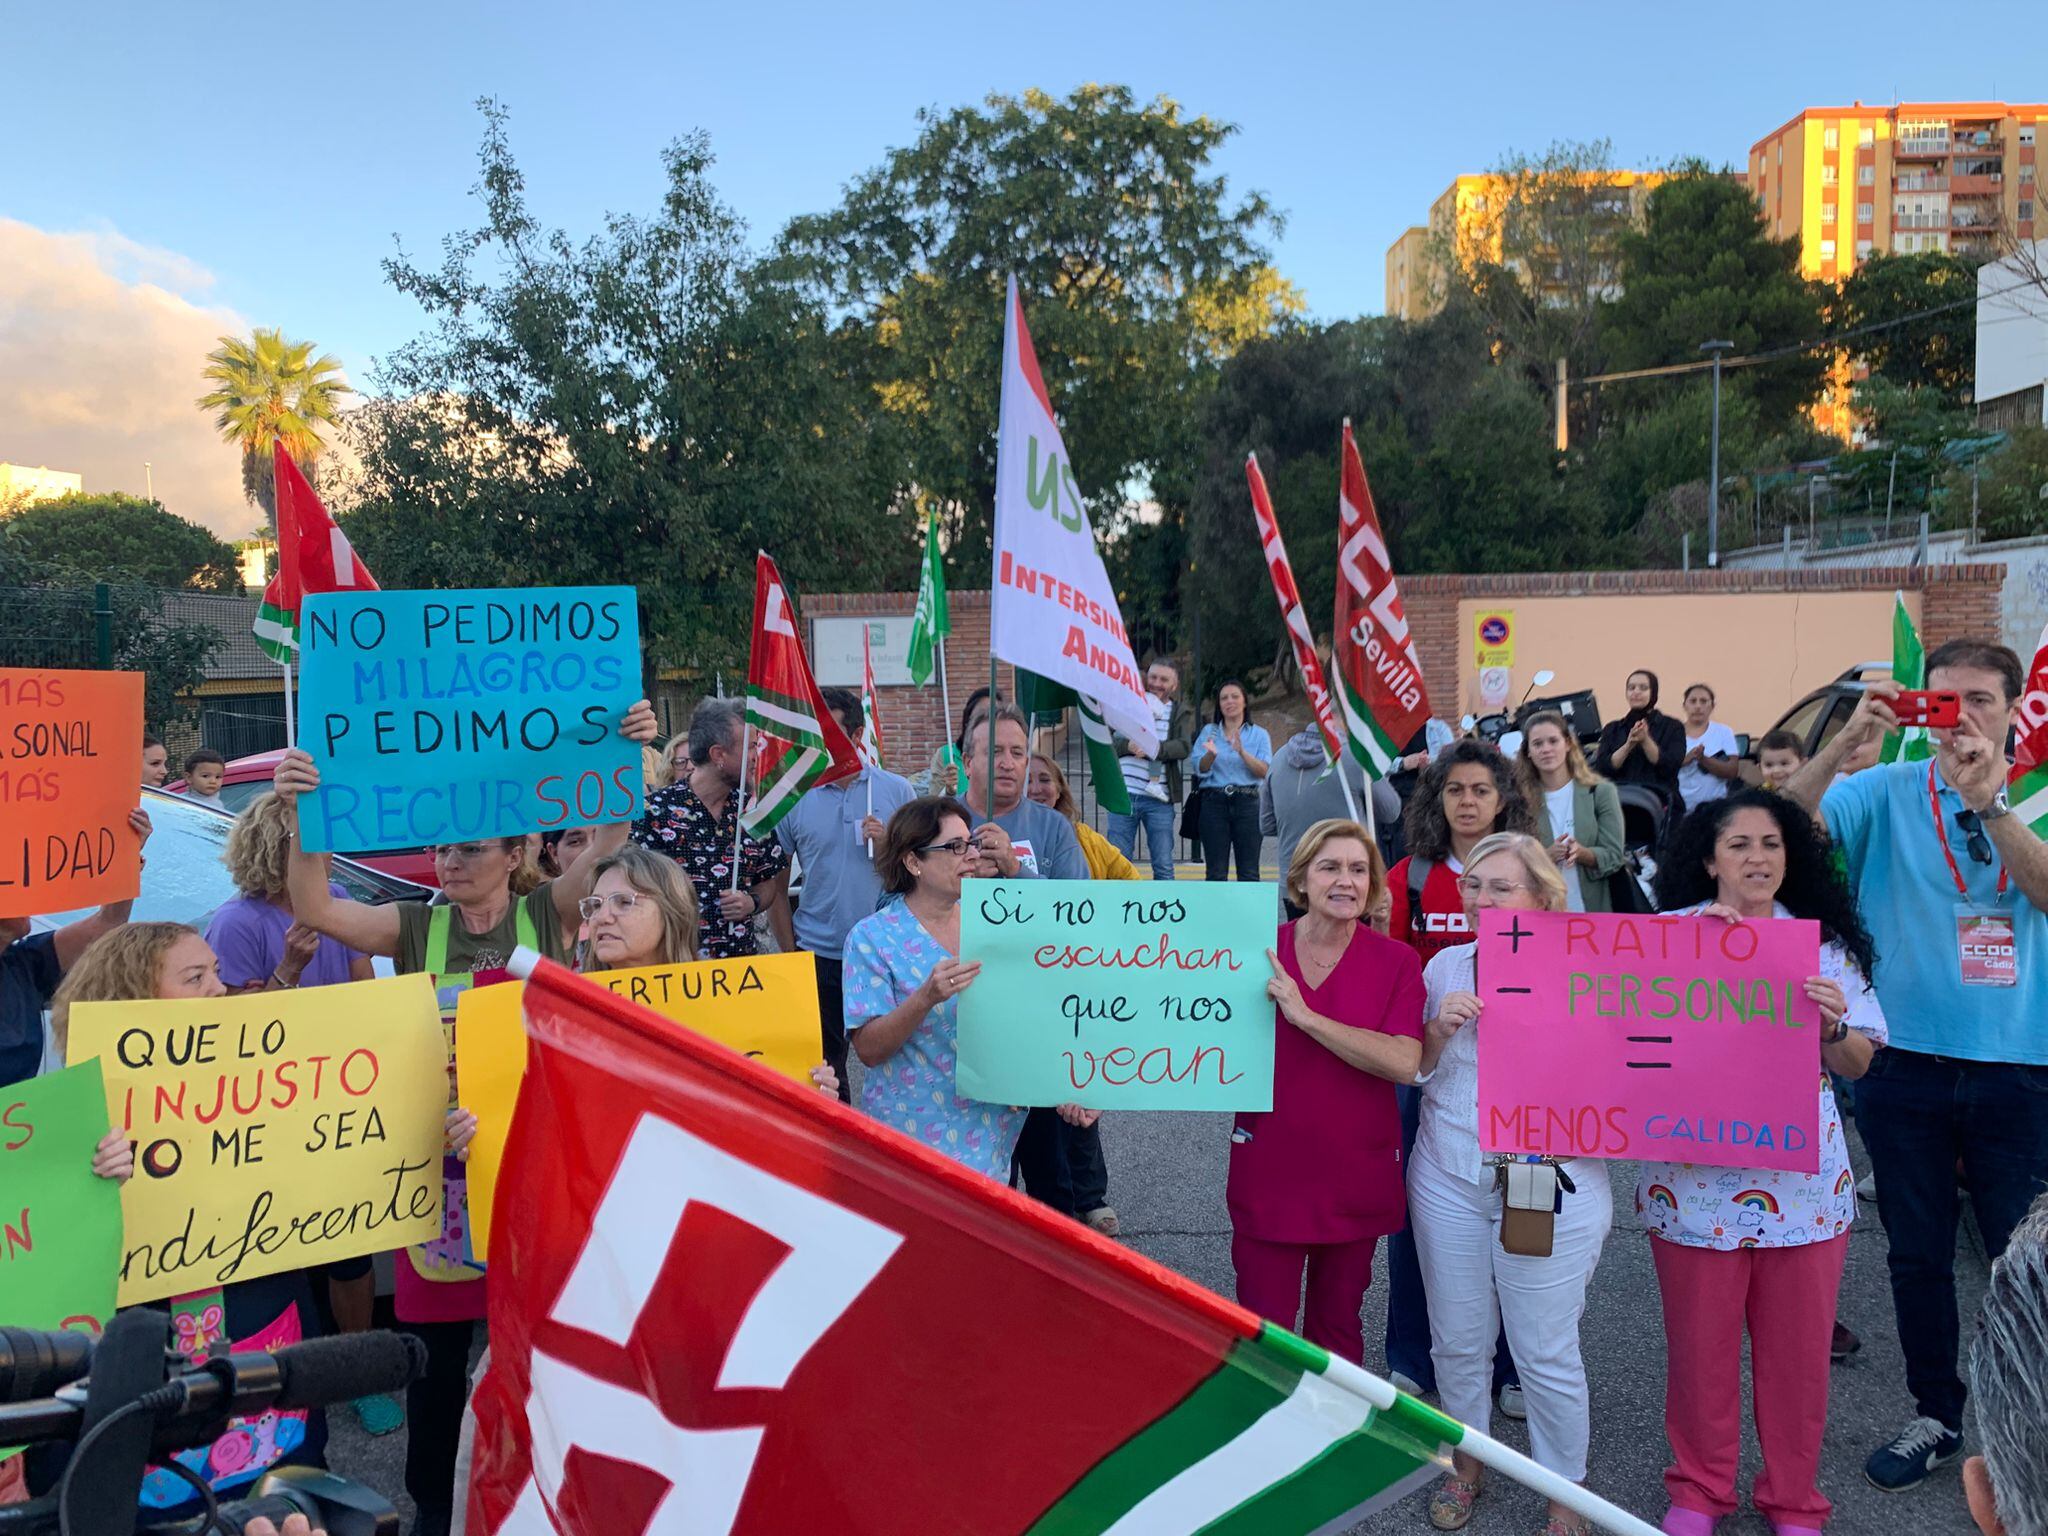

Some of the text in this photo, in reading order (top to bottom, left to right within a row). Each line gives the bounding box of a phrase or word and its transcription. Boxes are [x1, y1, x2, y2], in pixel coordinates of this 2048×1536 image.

[1026, 434, 1083, 534] US
[311, 602, 620, 650] NO PEDIMOS
[353, 651, 624, 704] MILAGROS
[1350, 614, 1420, 713] Sevilla
[0, 721, 98, 758] SONAL
[325, 706, 609, 757] PEDIMOS
[981, 887, 1187, 925] Si no nos
[1034, 933, 1243, 971] escuchan
[1566, 918, 1759, 962] RATIO
[1961, 944, 2014, 956] CCOO
[1061, 994, 1232, 1038] que nos
[1569, 972, 1805, 1028] PERSONAL
[117, 1019, 285, 1069] QUE LO
[1062, 1045, 1245, 1088] vean
[124, 1048, 379, 1131] INJUSTO
[211, 1124, 266, 1168] ME
[305, 1106, 386, 1153] SEA
[1490, 1104, 1807, 1154] MENOS CALIDAD
[119, 1158, 437, 1282] ndiferente
